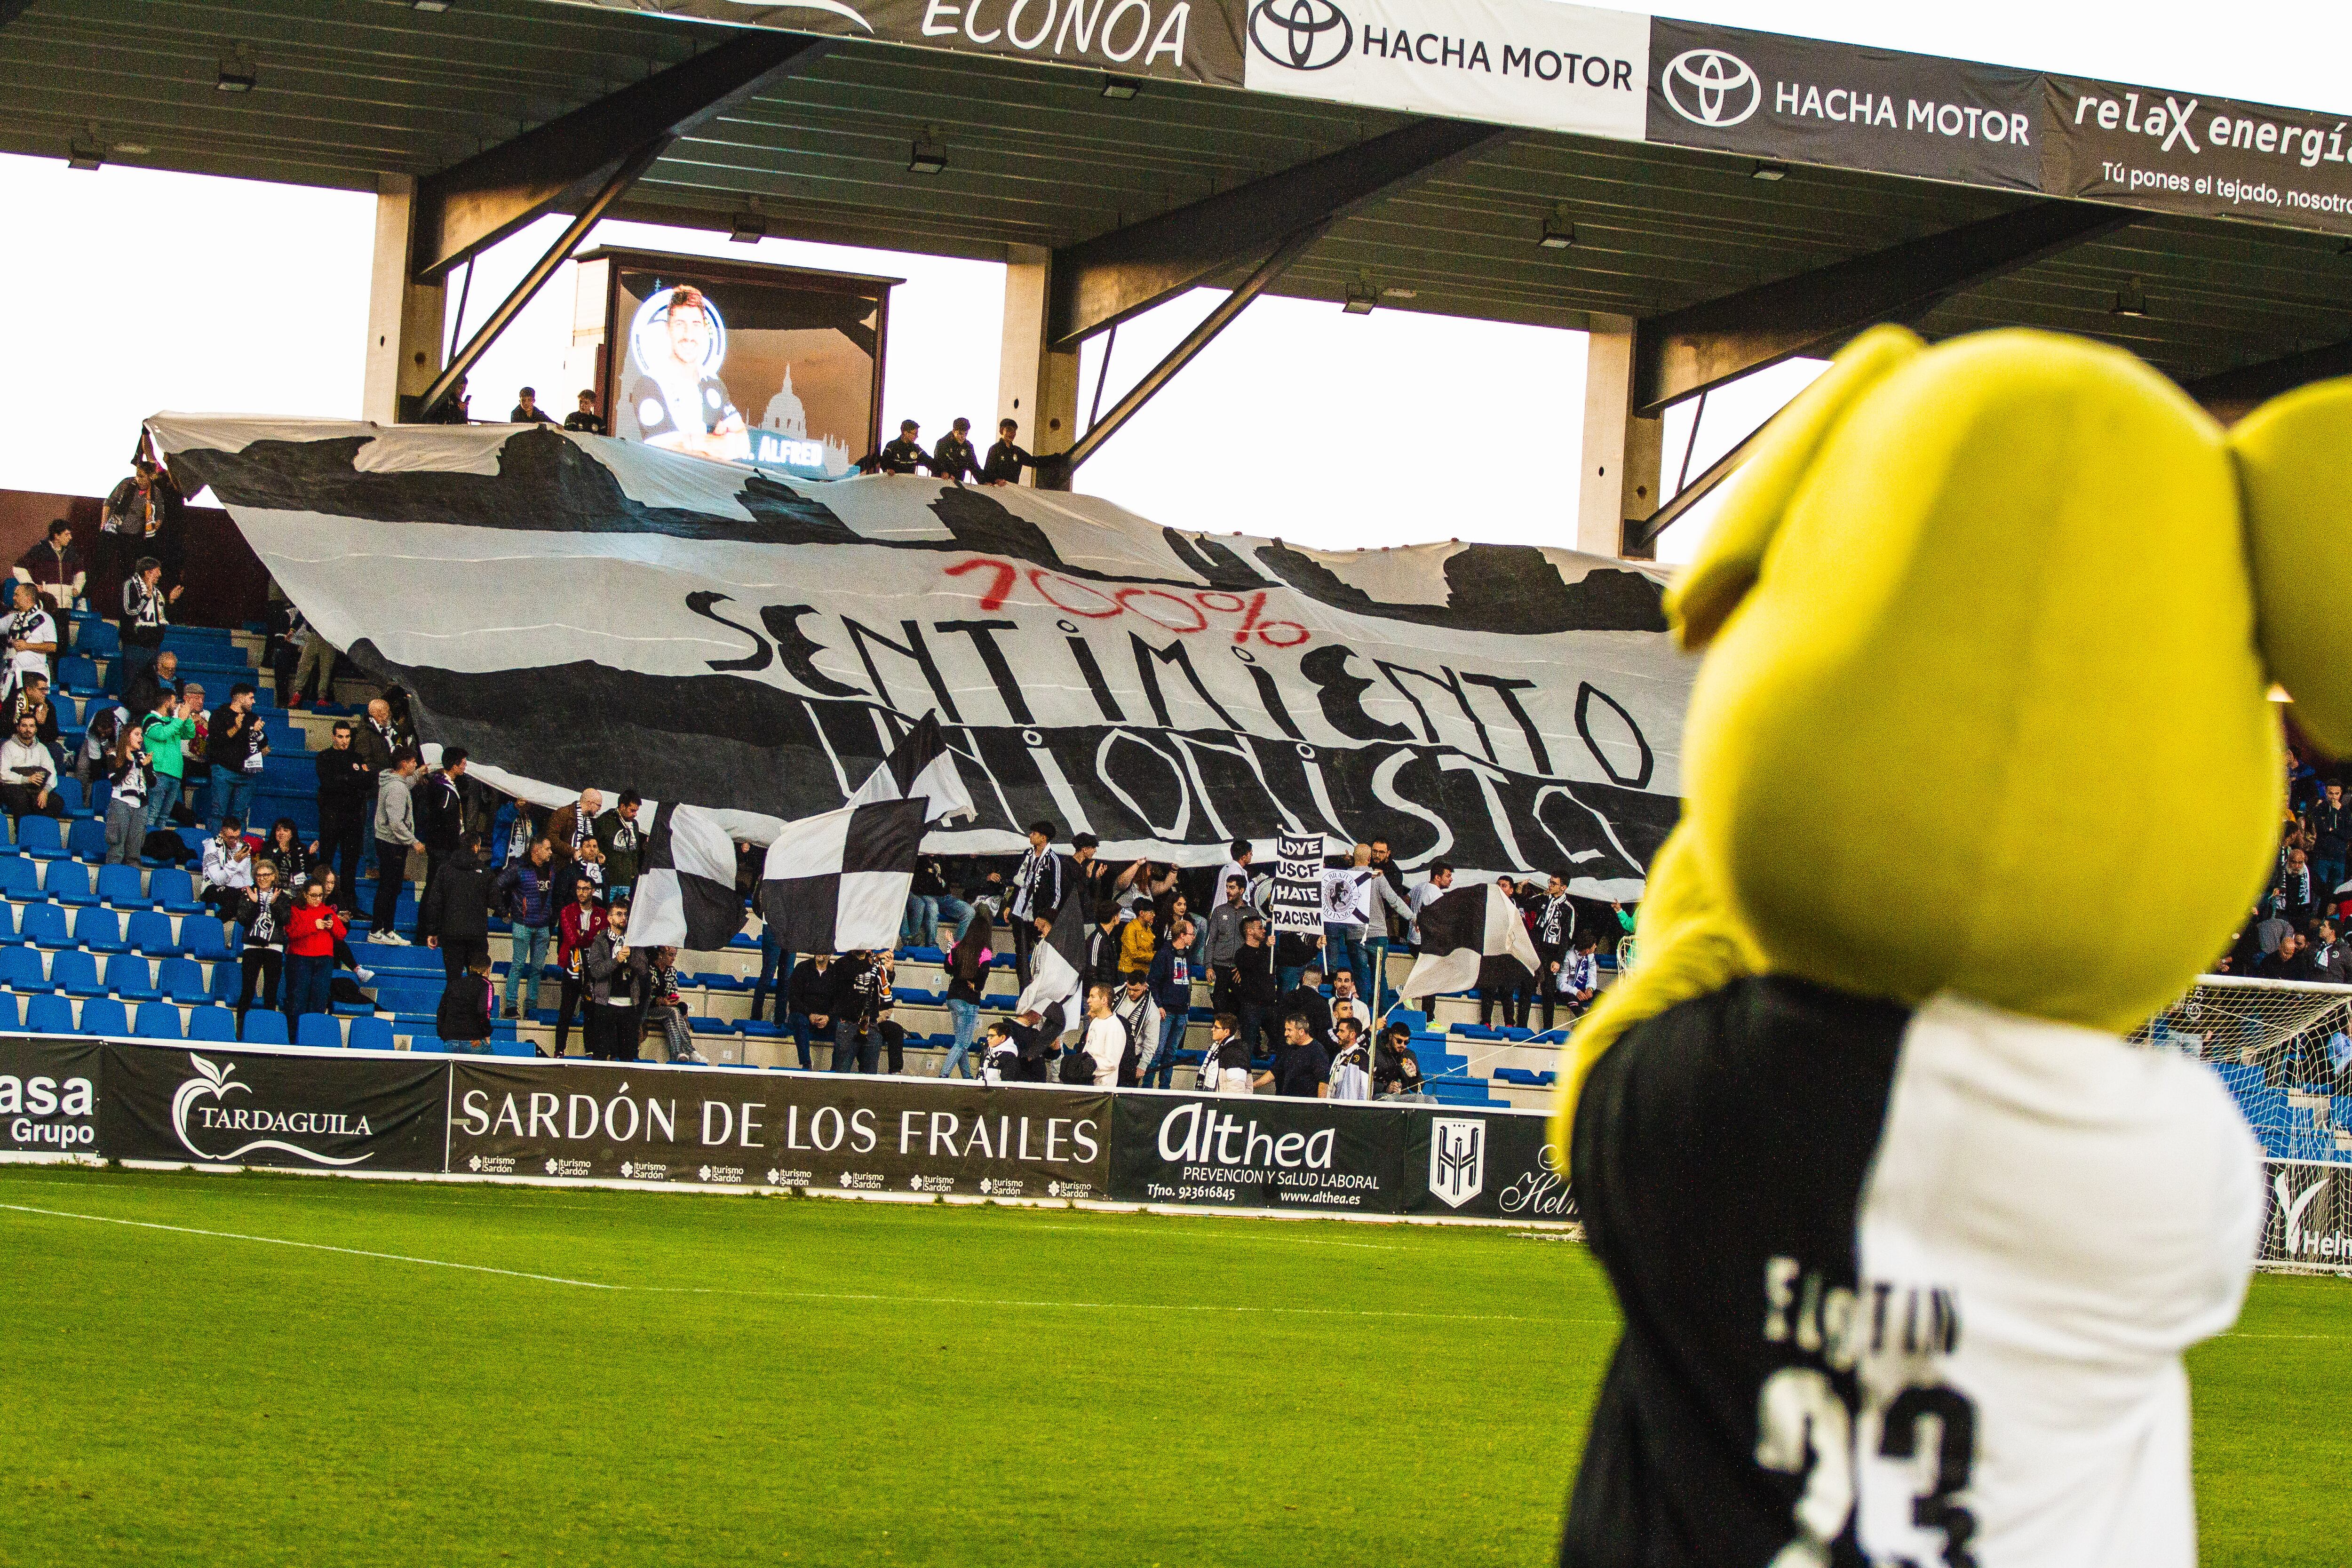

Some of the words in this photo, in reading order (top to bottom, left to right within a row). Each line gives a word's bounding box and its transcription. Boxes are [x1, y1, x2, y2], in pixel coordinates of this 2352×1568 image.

[922, 0, 1190, 66] ECONOA
[1363, 24, 1491, 72] HACHA
[1503, 45, 1633, 91] MOTOR
[1776, 81, 1897, 128] HACHA
[1907, 99, 2030, 146] MOTOR
[2074, 93, 2201, 154] relaX
[2209, 122, 2352, 167] energí
[2102, 162, 2125, 183] Tú
[2130, 167, 2190, 191] pones
[2195, 176, 2211, 194] el
[2217, 178, 2282, 207] tejado,
[758, 435, 823, 466] ALFRED
[944, 558, 1311, 647] 100%
[1279, 836, 1320, 855] LOVE
[1277, 860, 1320, 878] USCF
[1276, 885, 1320, 901] HATE
[1274, 910, 1322, 926] RACISM
[0, 1075, 93, 1116] asa
[198, 1106, 373, 1135] TARDAGUILA
[462, 1082, 676, 1143] SARDÓN
[702, 1100, 767, 1147] DE
[787, 1105, 877, 1154] LOS
[900, 1111, 1098, 1163] FRAILES
[11, 1117, 95, 1149] Grupo
[485, 1156, 516, 1165] turismo
[560, 1159, 591, 1168] turismo
[484, 1164, 512, 1173] Sardón
[560, 1167, 588, 1175] Sardón
[636, 1162, 667, 1171] turismo
[714, 1166, 744, 1175] turismo
[635, 1170, 663, 1179] Sardón
[714, 1173, 741, 1182] Sardón
[782, 1169, 812, 1178] turismo
[855, 1172, 884, 1181] turismo
[1183, 1167, 1263, 1183] PREVENCION
[1267, 1170, 1275, 1184] Y
[1321, 1173, 1380, 1190] LABORAL
[781, 1177, 809, 1186] Sardón
[854, 1180, 881, 1189] Sardón
[925, 1175, 954, 1184] turismo
[994, 1178, 1024, 1187] turismo
[924, 1183, 951, 1192] Sardón
[993, 1186, 1020, 1195] Sardón
[1063, 1181, 1092, 1190] turismo
[1062, 1189, 1089, 1198] Sardón
[1147, 1183, 1175, 1198] Tfno.
[1179, 1186, 1235, 1201] 923616845
[1280, 1191, 1361, 1205] www.althea.es
